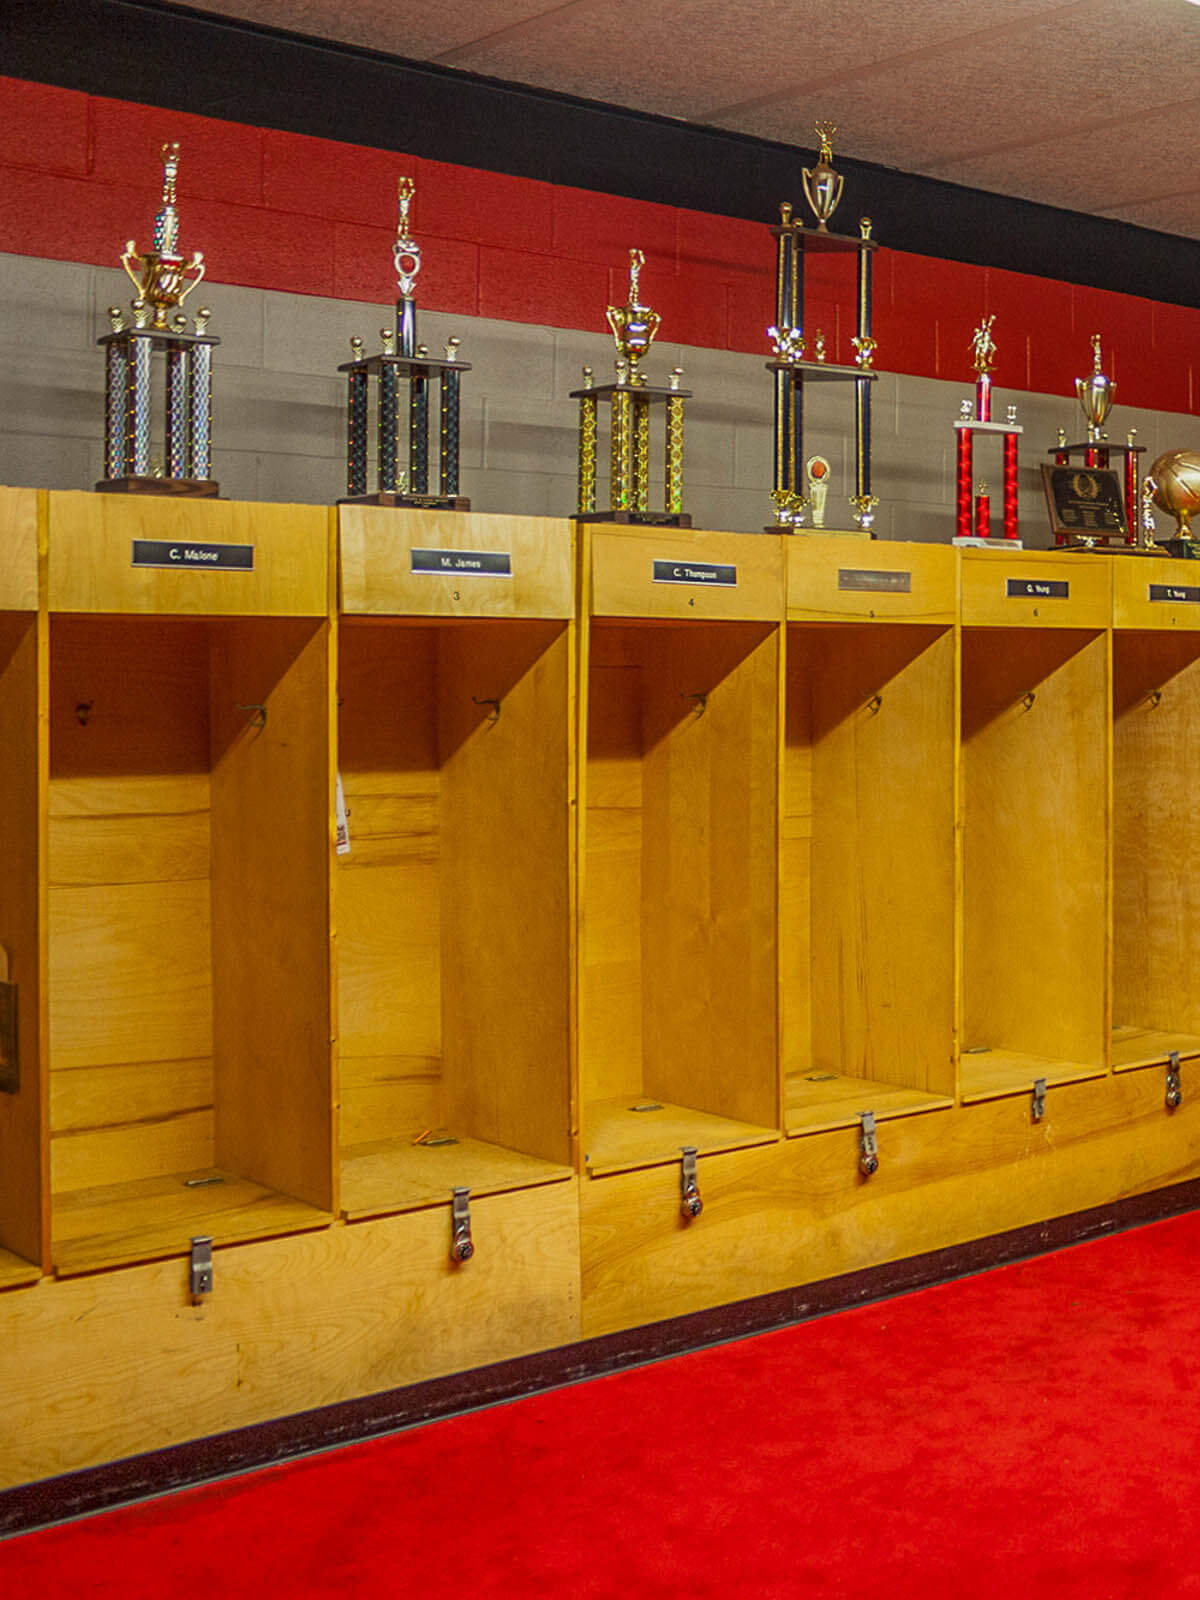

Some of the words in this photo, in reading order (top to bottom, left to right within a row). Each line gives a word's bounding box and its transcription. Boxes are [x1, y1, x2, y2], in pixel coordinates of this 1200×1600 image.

[169, 548, 181, 560] C.
[184, 549, 218, 562] Malone
[440, 557, 452, 567] M.
[455, 558, 481, 569] James
[453, 591, 460, 601] 3
[688, 597, 694, 607] 4
